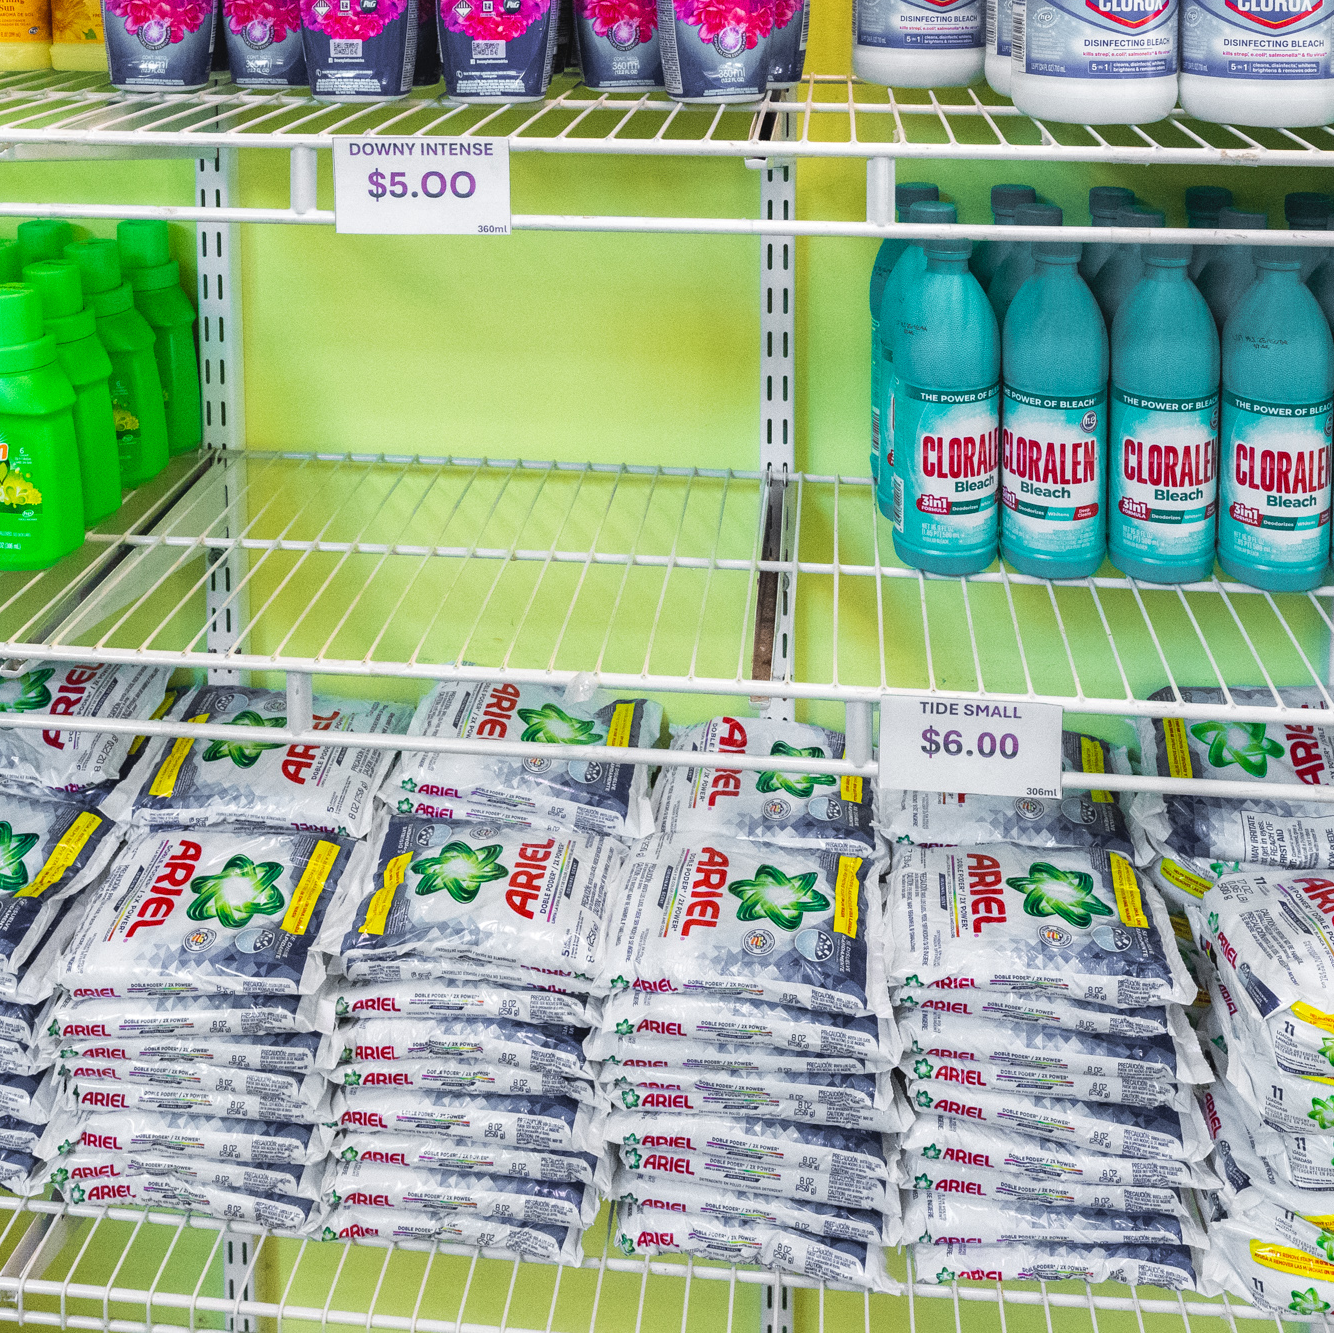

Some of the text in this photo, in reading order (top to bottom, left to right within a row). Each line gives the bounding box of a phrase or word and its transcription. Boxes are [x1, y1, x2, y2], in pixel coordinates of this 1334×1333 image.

[350, 143, 493, 156] DOWNY INTENSE
[368, 168, 476, 202] $5.00
[478, 225, 507, 233] 360ml
[1011, 393, 1041, 406] POWER
[1044, 399, 1057, 408] OF
[1003, 428, 1095, 485] CLORALEN
[1021, 481, 1070, 498] Bleach
[922, 495, 947, 508] 3in1
[1267, 494, 1317, 508] Bleach
[920, 702, 1022, 719] TIDE SMALL
[920, 726, 1019, 760] $6.00
[1026, 787, 1057, 798] 306ml
[506, 838, 553, 919] ARIEL
[126, 840, 202, 937] ARIEL
[681, 847, 729, 937] ARIEL
[967, 853, 1006, 934] ARIEL
[351, 997, 401, 1013] ARIEL
